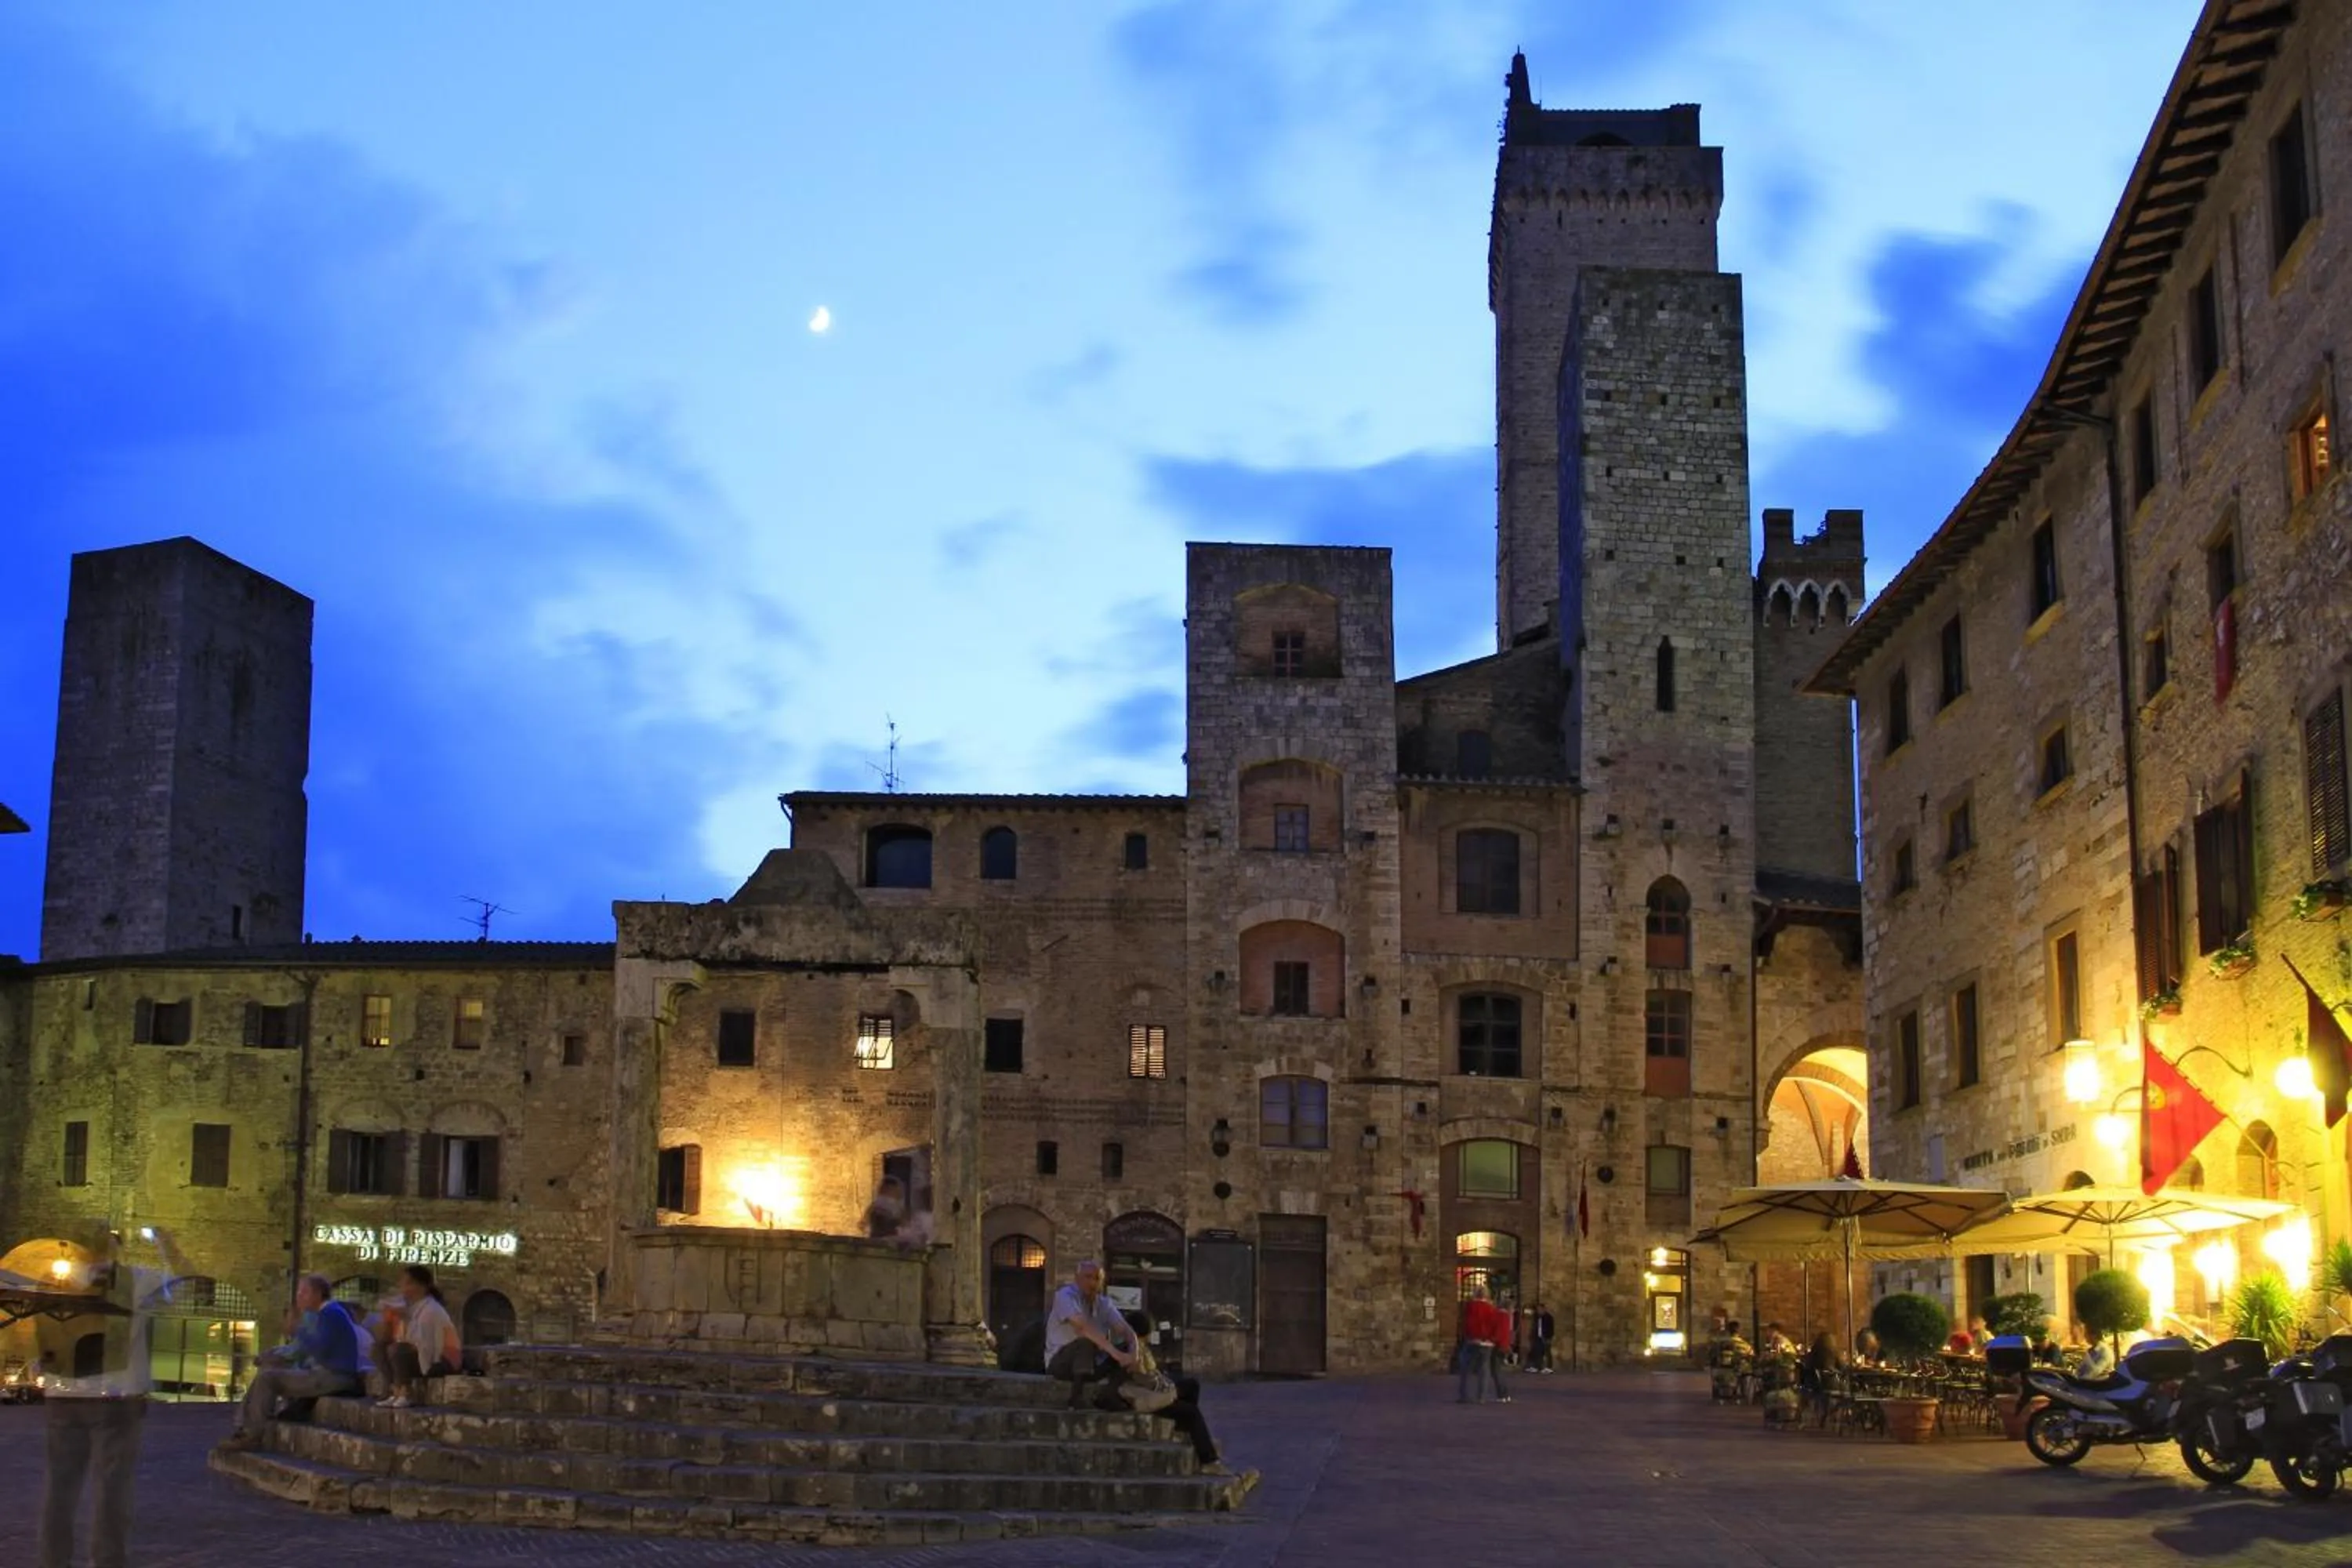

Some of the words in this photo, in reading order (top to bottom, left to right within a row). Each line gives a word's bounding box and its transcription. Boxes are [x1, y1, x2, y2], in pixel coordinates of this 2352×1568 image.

[314, 1225, 375, 1243] CASSA
[382, 1227, 405, 1246] DI
[411, 1229, 517, 1254] RISPARMIO
[356, 1245, 379, 1261] DI
[386, 1247, 470, 1266] FIRENZE
